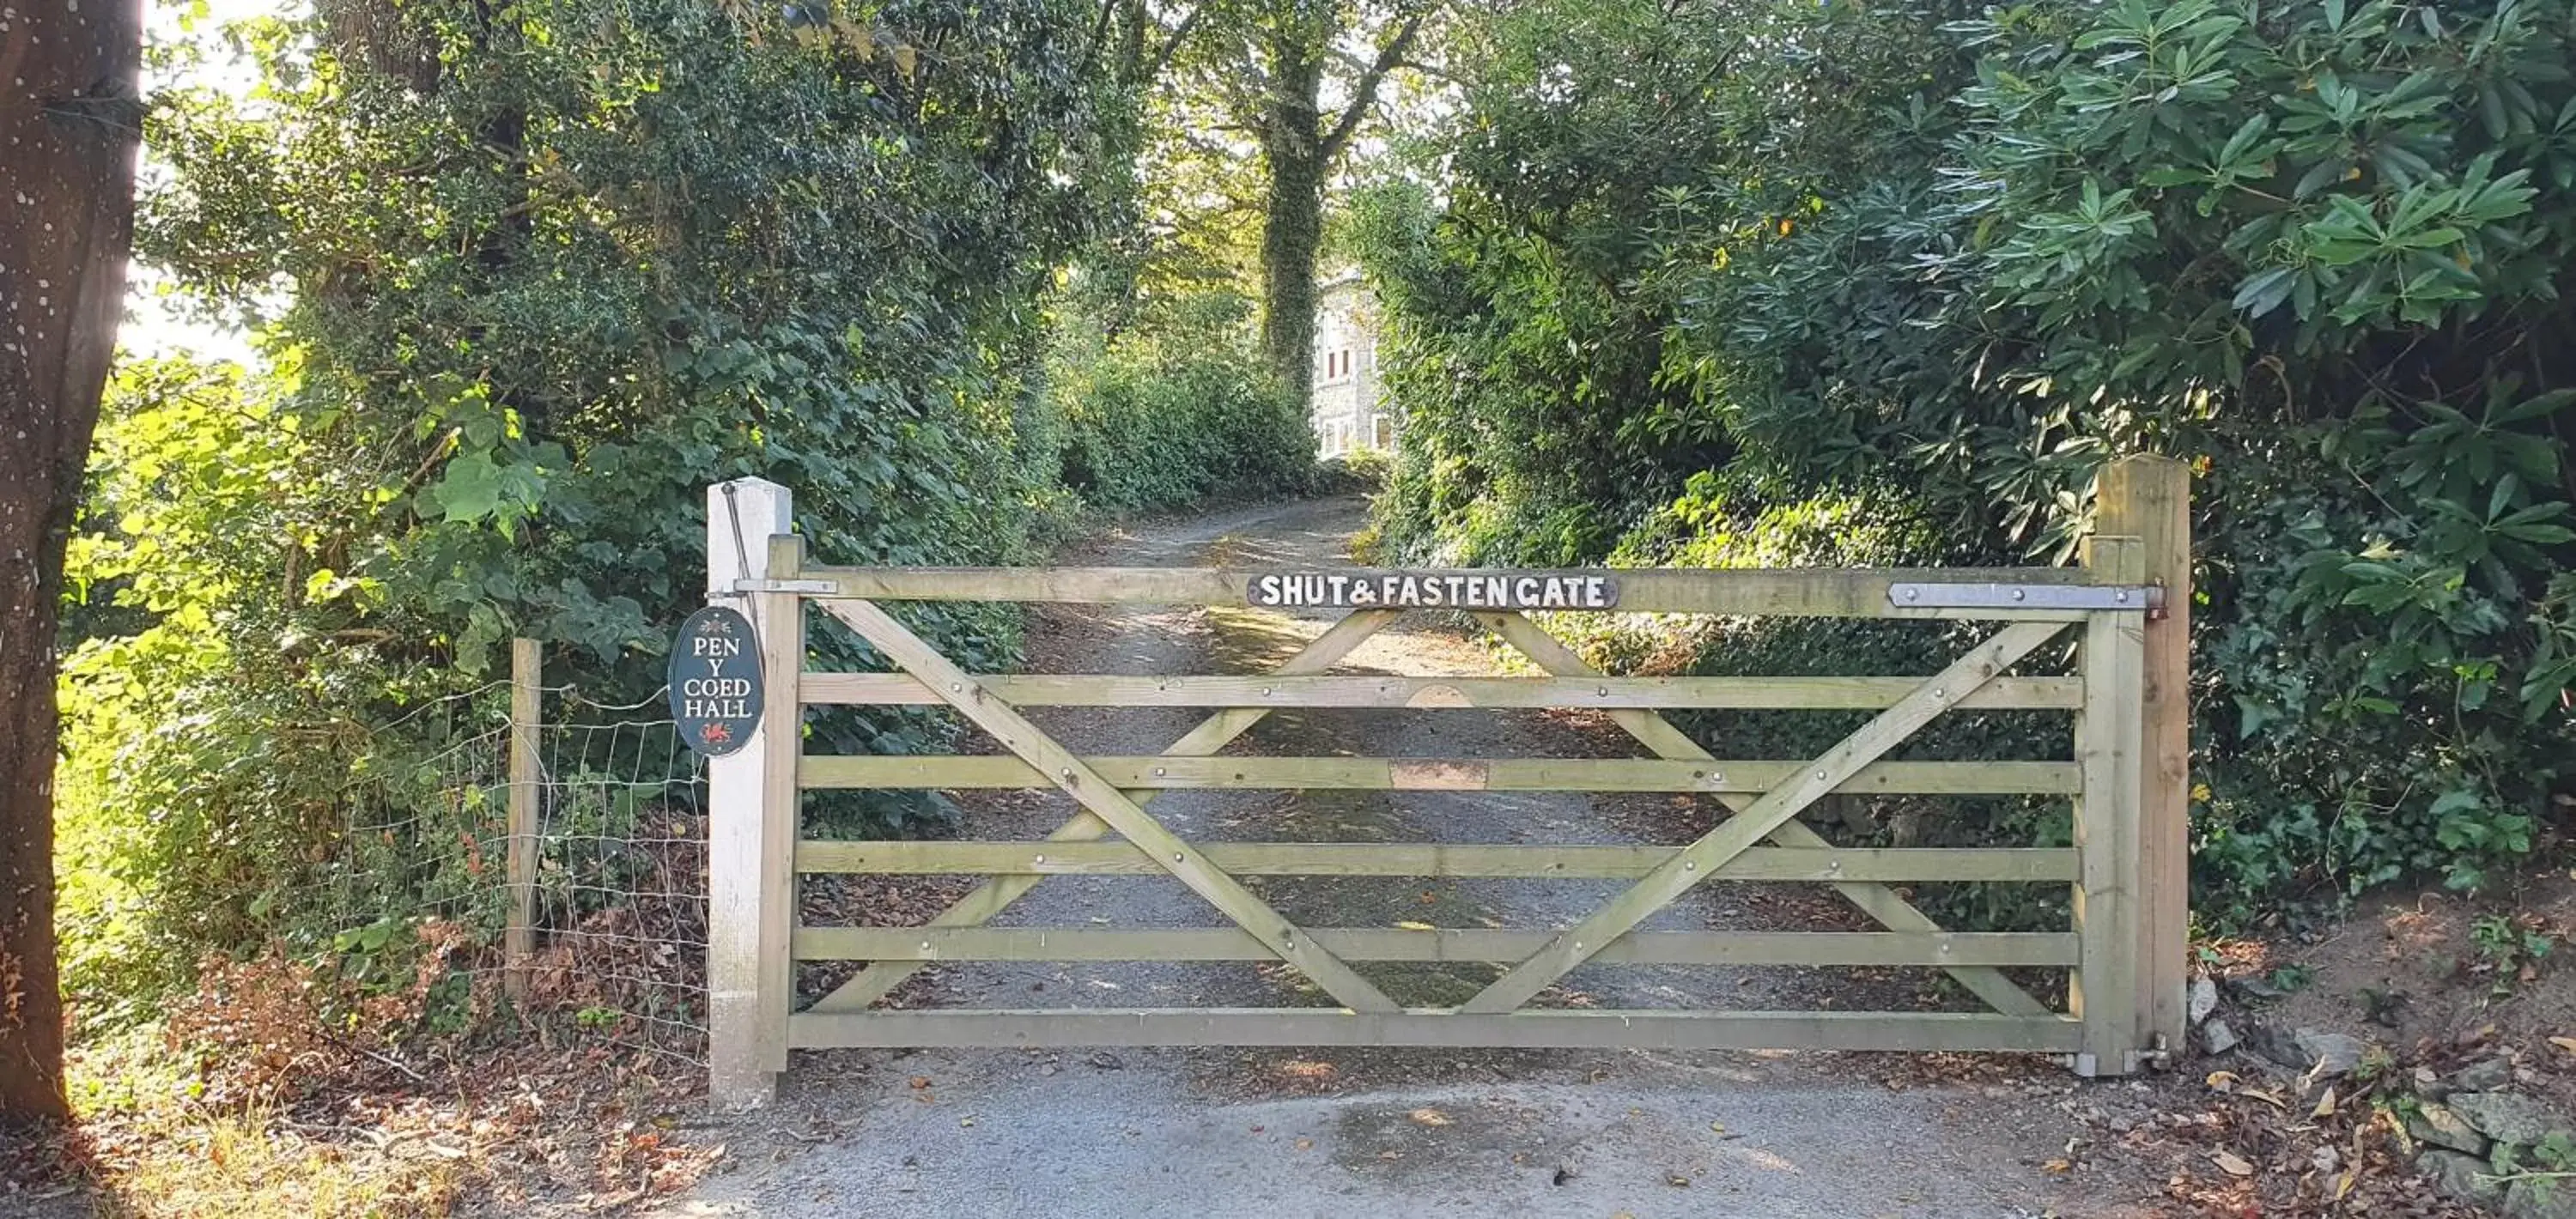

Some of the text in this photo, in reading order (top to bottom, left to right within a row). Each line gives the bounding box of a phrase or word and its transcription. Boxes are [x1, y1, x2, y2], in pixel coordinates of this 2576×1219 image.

[1260, 575, 1346, 605] SHUT
[1383, 576, 1507, 606] FASTEN
[1516, 576, 1606, 606] GATE
[693, 637, 740, 657] PEN
[708, 658, 724, 677] Y
[683, 678, 751, 697] COED
[684, 700, 753, 718] HALL
